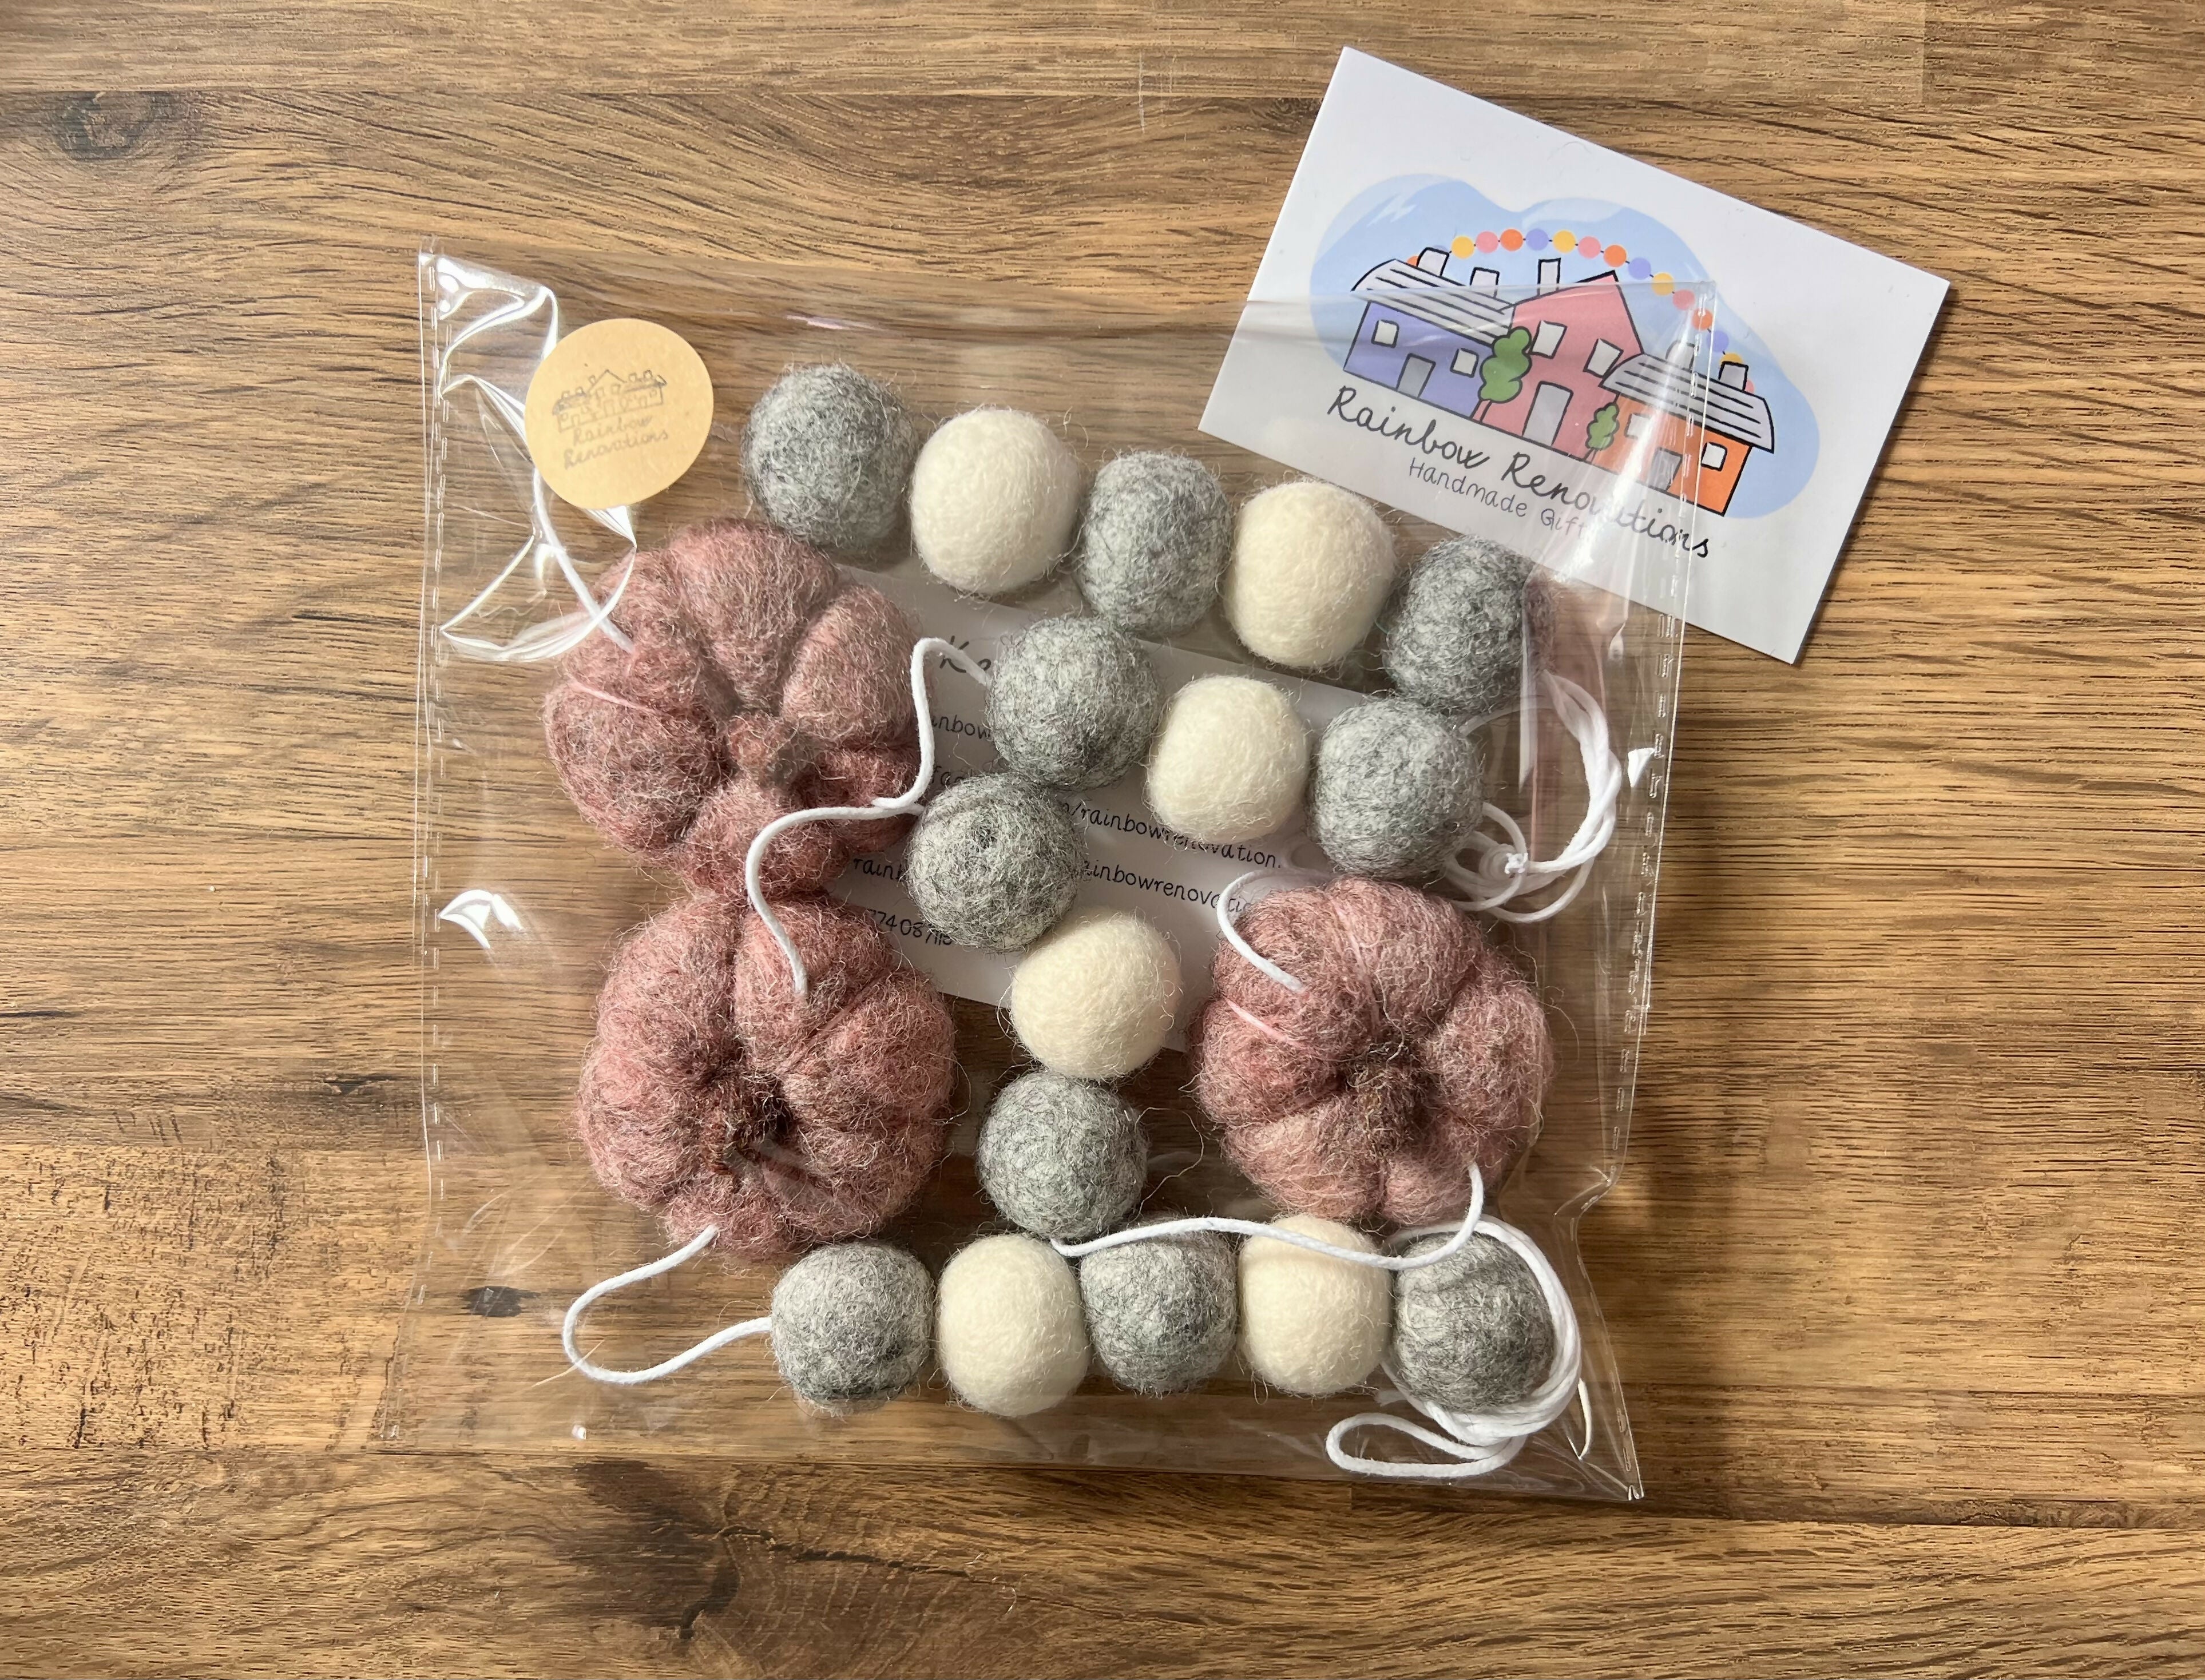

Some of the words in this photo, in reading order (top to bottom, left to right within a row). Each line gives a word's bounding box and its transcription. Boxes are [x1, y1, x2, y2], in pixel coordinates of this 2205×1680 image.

[564, 430, 669, 470] Renovations
[573, 416, 653, 446] Rainbow
[1327, 385, 1490, 469] Rainbow
[1409, 457, 1528, 517] Handmade
